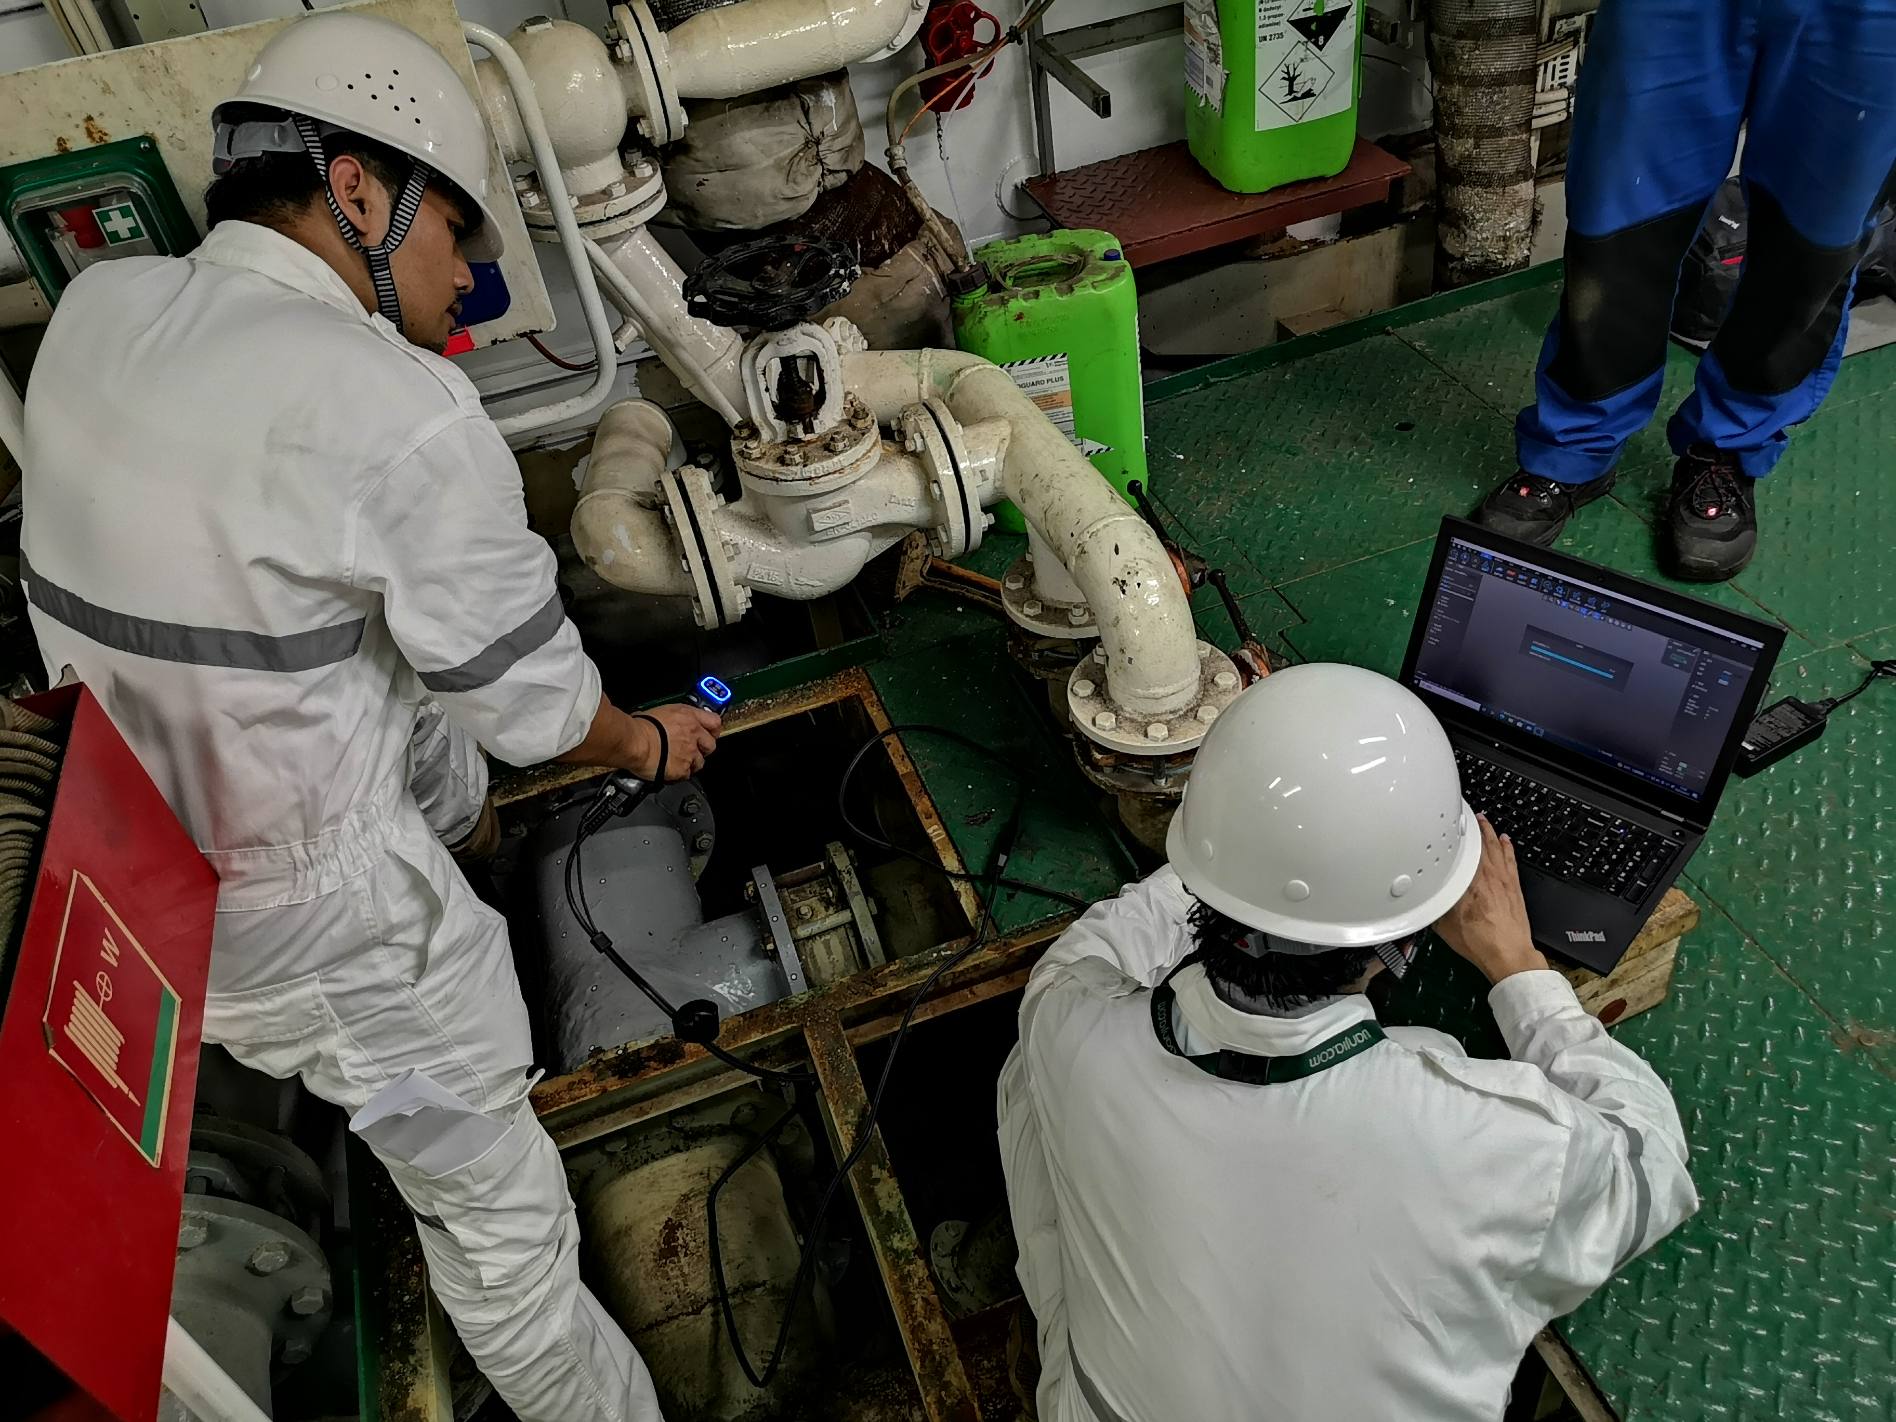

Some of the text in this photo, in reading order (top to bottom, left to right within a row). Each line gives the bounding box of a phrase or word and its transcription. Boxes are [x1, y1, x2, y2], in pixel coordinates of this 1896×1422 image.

[1269, 32, 1284, 41] 2735
[1318, 35, 1324, 45] 8
[1046, 376, 1064, 385] PLUS
[1565, 930, 1607, 943] ThinkPad
